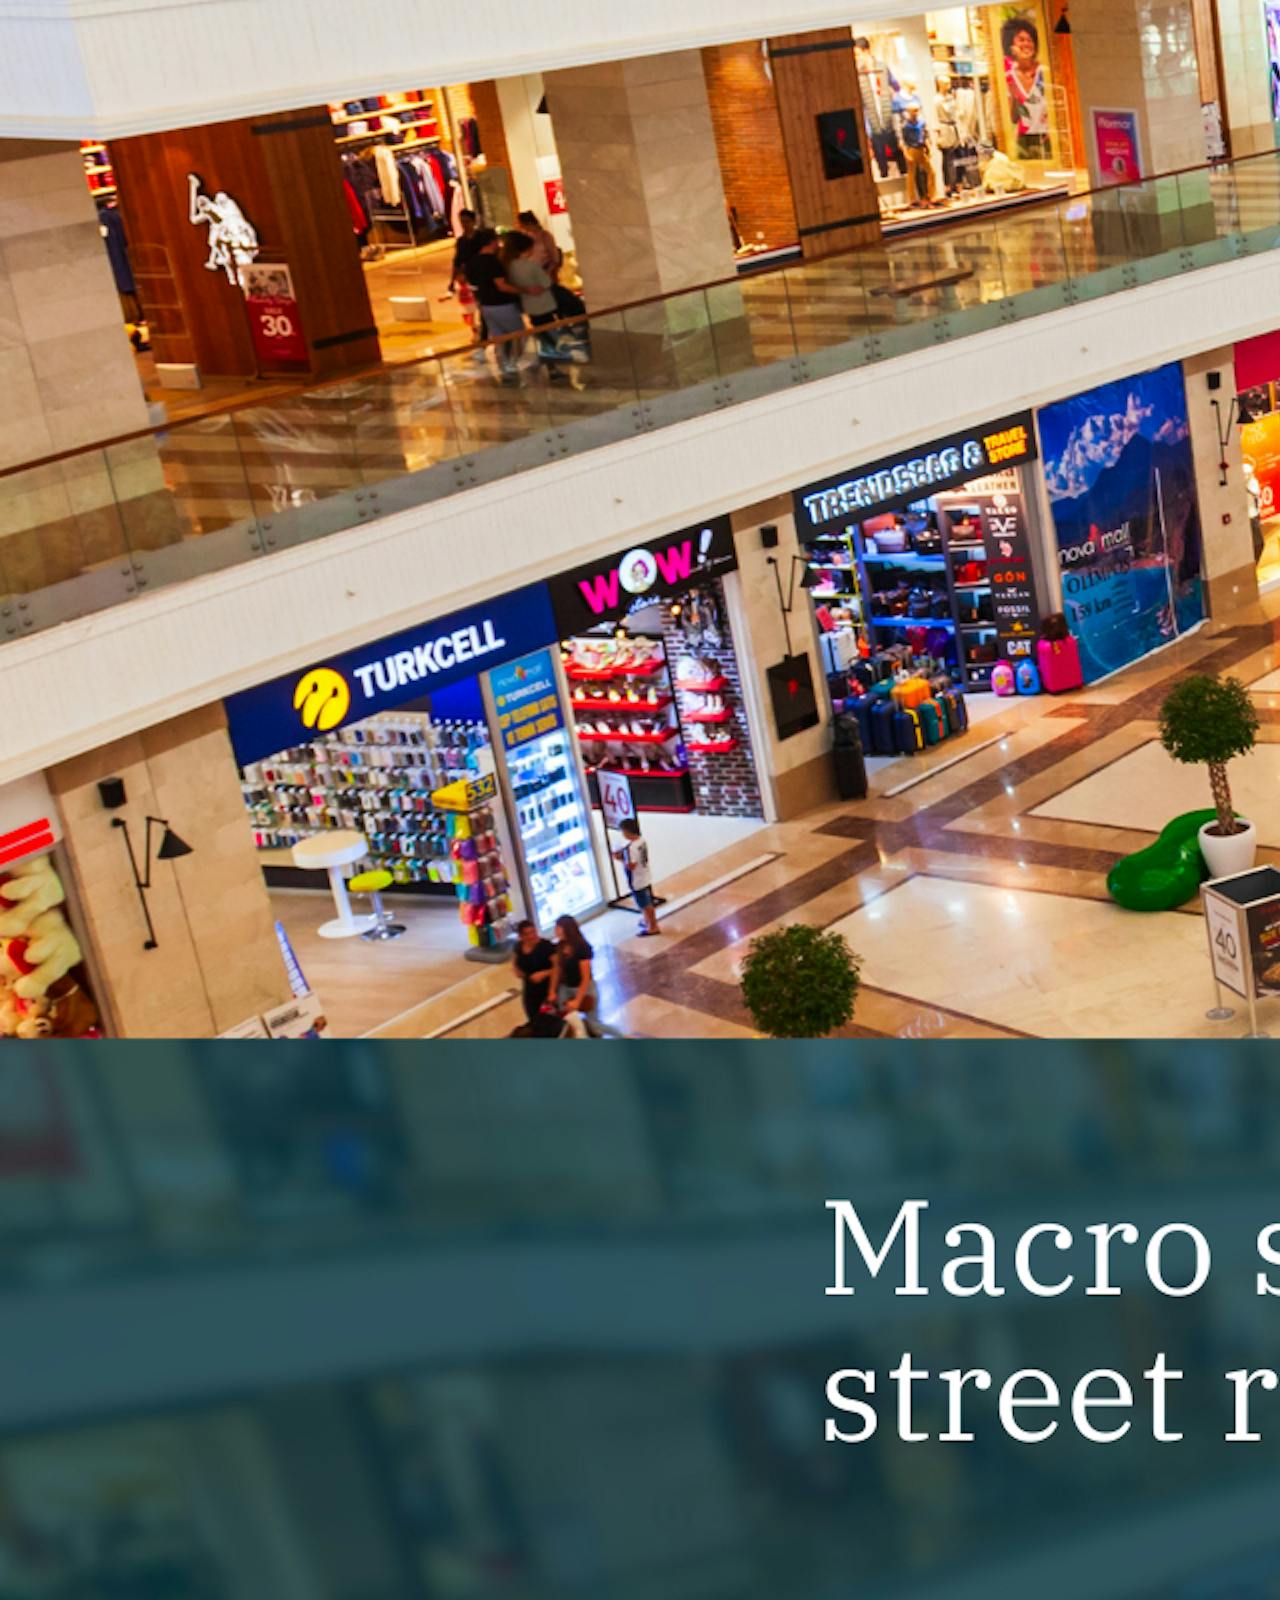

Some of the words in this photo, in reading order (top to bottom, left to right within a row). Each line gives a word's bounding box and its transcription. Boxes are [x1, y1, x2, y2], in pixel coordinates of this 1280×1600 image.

[260, 315, 293, 337] 30
[983, 426, 1027, 449] TRAVEL
[988, 440, 1026, 464] STORE
[803, 447, 960, 524] TRENDSBAG
[963, 440, 984, 470] &
[353, 619, 506, 698] TURKCELL
[1007, 640, 1031, 655] CAT
[604, 784, 631, 816] 40
[1215, 928, 1237, 960] 40
